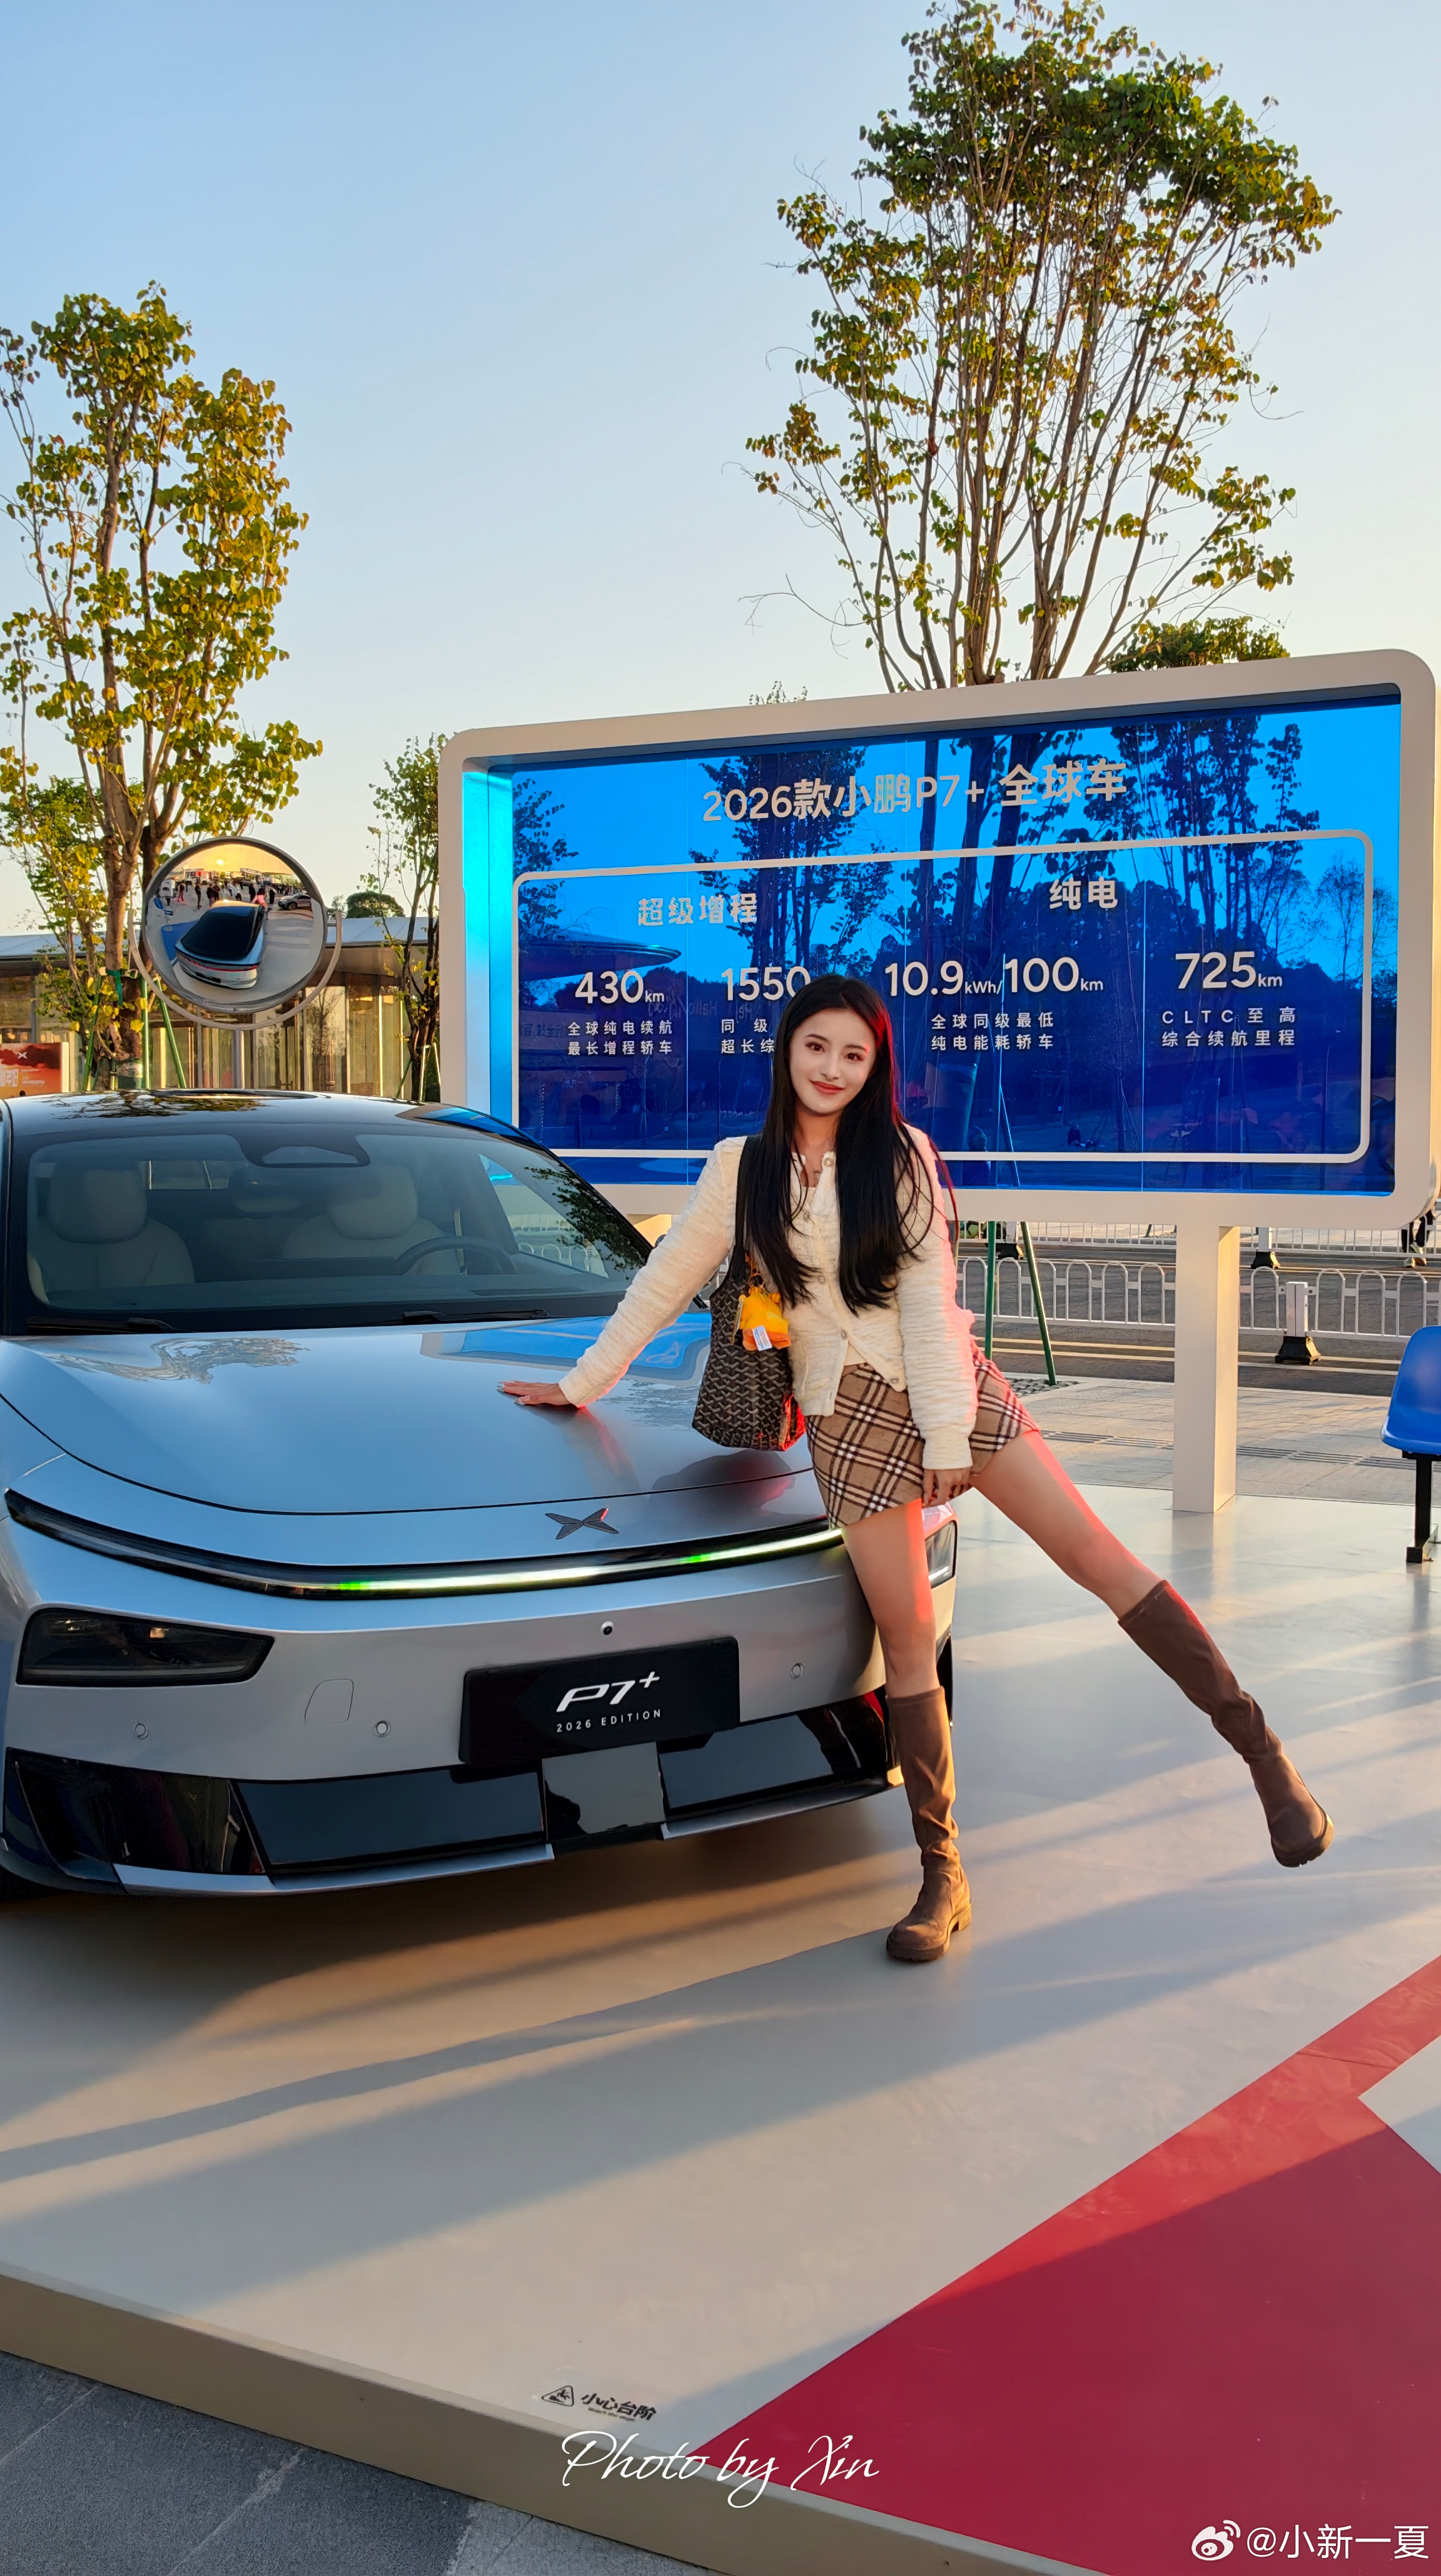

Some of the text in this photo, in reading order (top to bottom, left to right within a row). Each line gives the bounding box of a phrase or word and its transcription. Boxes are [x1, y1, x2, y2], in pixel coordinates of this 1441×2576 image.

[998, 758, 1127, 807] 全球车
[1049, 875, 1118, 910] 纯电
[638, 893, 757, 926] 超级增程
[568, 1020, 673, 1036] 全球纯电续航
[931, 1012, 1054, 1030] 全球同级最低
[568, 1040, 673, 1056] 最长增程轿车
[931, 1033, 1054, 1051] 纯电能耗轿车
[1161, 1029, 1295, 1047] 综合续航里程
[556, 1671, 660, 1713] P7+
[556, 1708, 661, 1733] 2026 EDITION
[581, 2393, 657, 2421] 小心台阶
